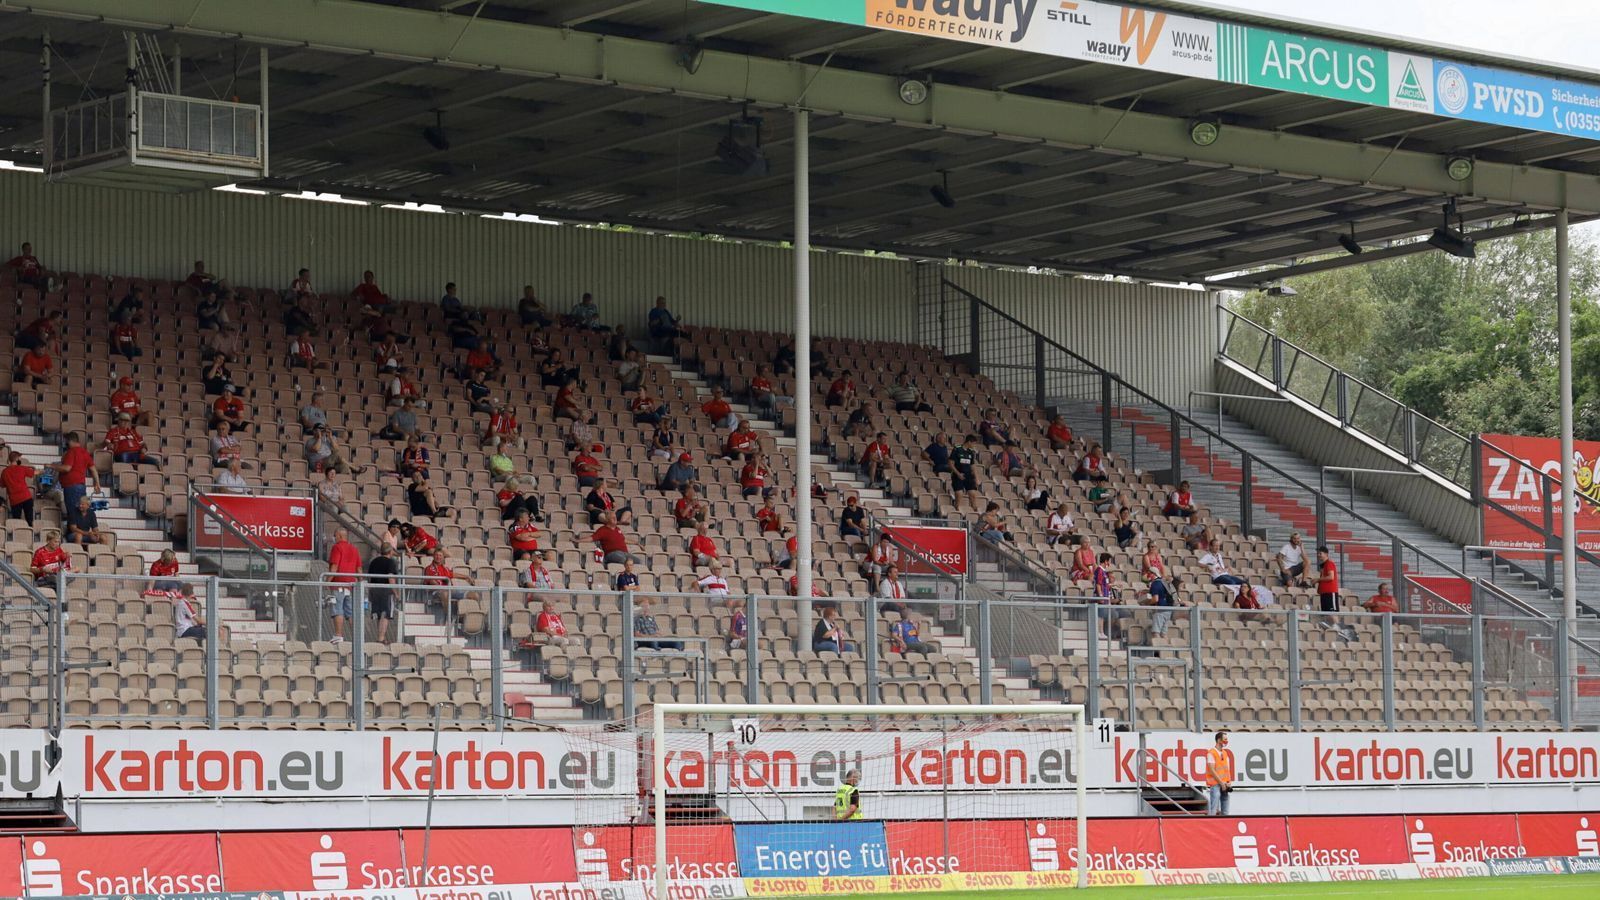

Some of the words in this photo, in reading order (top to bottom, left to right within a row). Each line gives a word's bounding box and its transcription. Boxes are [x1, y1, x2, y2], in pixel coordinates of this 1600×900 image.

[875, 11, 1005, 42] FÖRDERTECHNIK
[1047, 9, 1092, 26] STILL
[1086, 39, 1132, 63] waury
[1171, 49, 1213, 62] arcus-pb.de
[1261, 39, 1377, 94] ARCUS
[1473, 82, 1545, 119] PWSD
[738, 724, 757, 746] 10
[1098, 724, 1110, 743] 11
[85, 735, 344, 792] karton.eu
[383, 737, 616, 790] karton.eu
[1314, 737, 1473, 781] karton.eu
[756, 844, 852, 876] Energie
[1267, 842, 1361, 868] Sparkasse
[1442, 840, 1527, 863] Sparkasse
[360, 861, 494, 889] Sparkasse
[977, 873, 1014, 887] LOTTO
[1038, 873, 1073, 886] LOTTO
[1099, 872, 1136, 885] LOTTO
[1237, 866, 1309, 884] karton.eu
[1327, 866, 1399, 882] karton.eu
[1416, 863, 1484, 880] karton.eu
[766, 879, 808, 893] LOTTO
[834, 878, 876, 892] LOTTO
[902, 876, 943, 890] LOTTO
